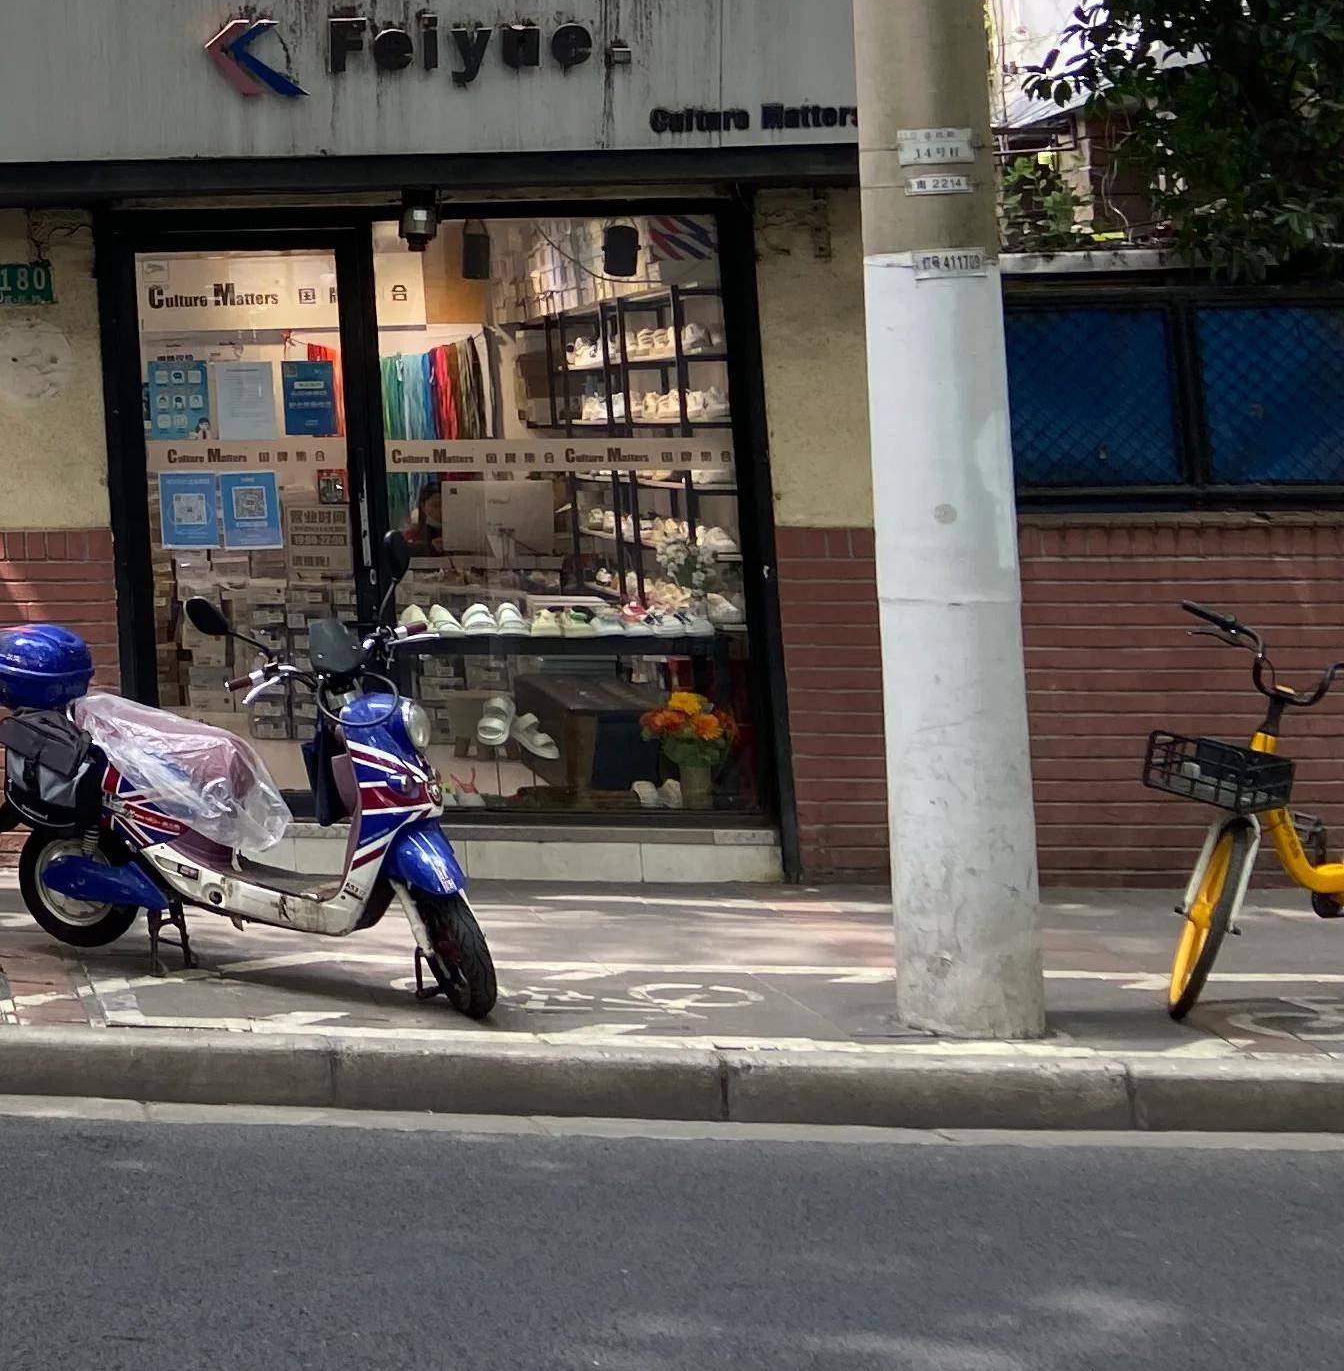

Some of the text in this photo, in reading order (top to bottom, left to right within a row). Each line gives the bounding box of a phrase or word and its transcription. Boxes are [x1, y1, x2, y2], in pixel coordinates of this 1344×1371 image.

[327, 16, 592, 83] Feiyue
[932, 178, 962, 189] 2214
[0, 267, 47, 291] 180
[148, 282, 279, 309] Culture Matters
